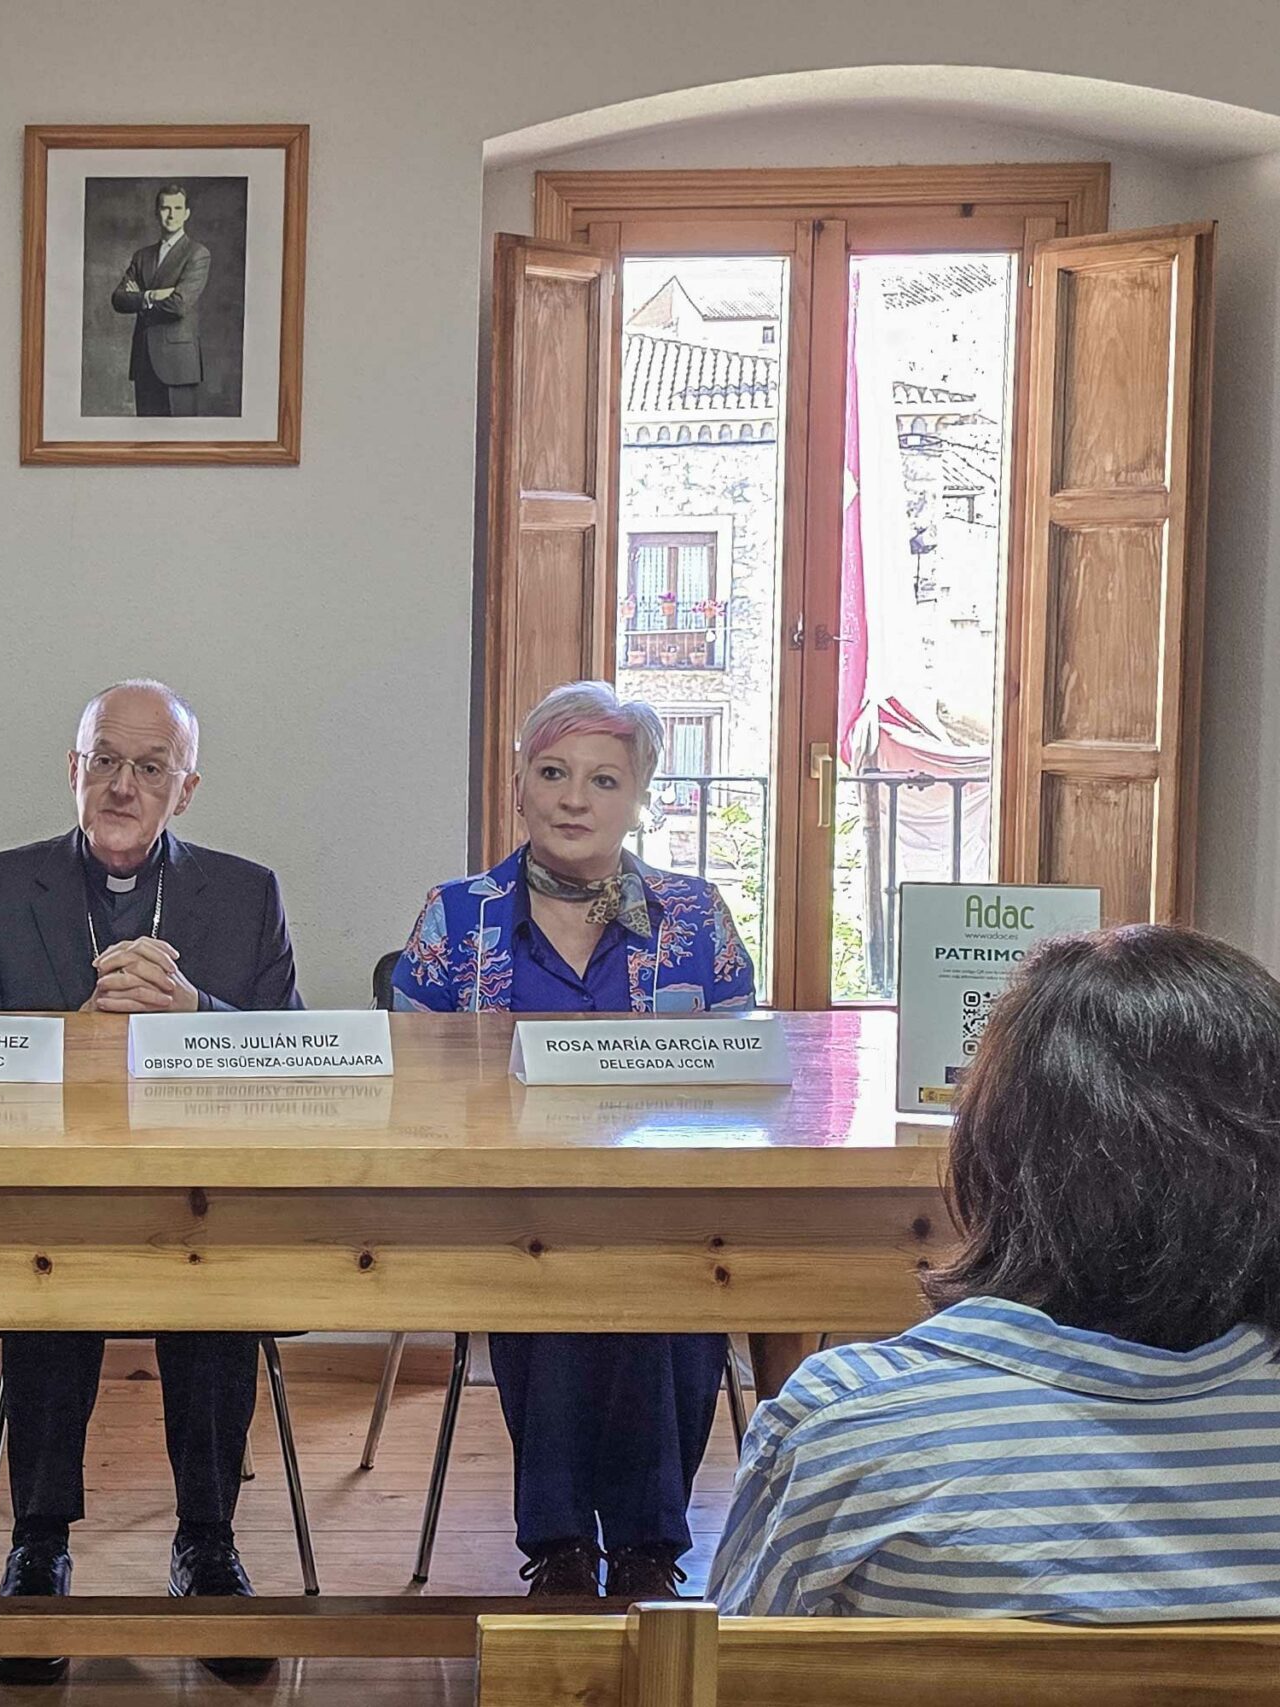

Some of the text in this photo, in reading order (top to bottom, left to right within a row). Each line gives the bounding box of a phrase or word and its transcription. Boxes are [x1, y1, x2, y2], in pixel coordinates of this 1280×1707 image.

[965, 894, 1035, 930] Adac
[184, 1033, 339, 1050] MONS. JULIÁN RUIZ
[546, 1035, 762, 1052] ROSA MARÍA GARCÍA RUIZ
[144, 1054, 383, 1069] OBISPO DE SIGÜENZA-GUADALAJARA
[600, 1058, 715, 1069] DELEGADA JCCM
